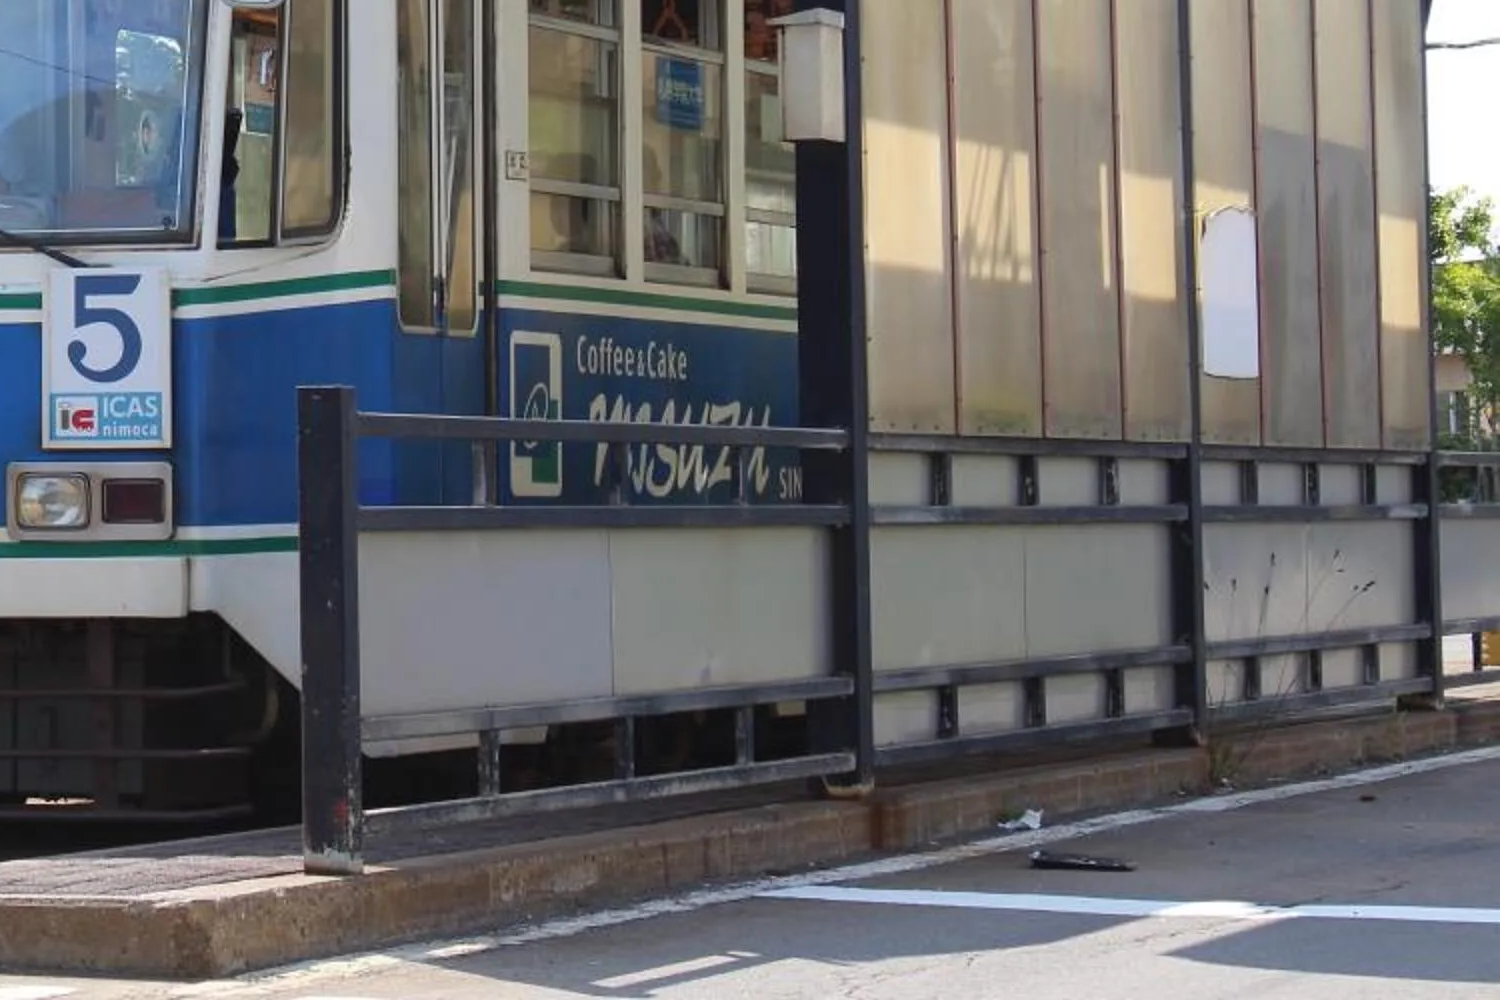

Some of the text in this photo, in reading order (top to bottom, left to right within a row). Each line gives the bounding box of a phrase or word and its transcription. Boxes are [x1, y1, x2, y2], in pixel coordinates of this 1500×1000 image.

[67, 273, 143, 383] 5
[577, 334, 688, 380] Coffee&Cake
[103, 396, 159, 418] ICAS
[103, 421, 158, 437] nimoca
